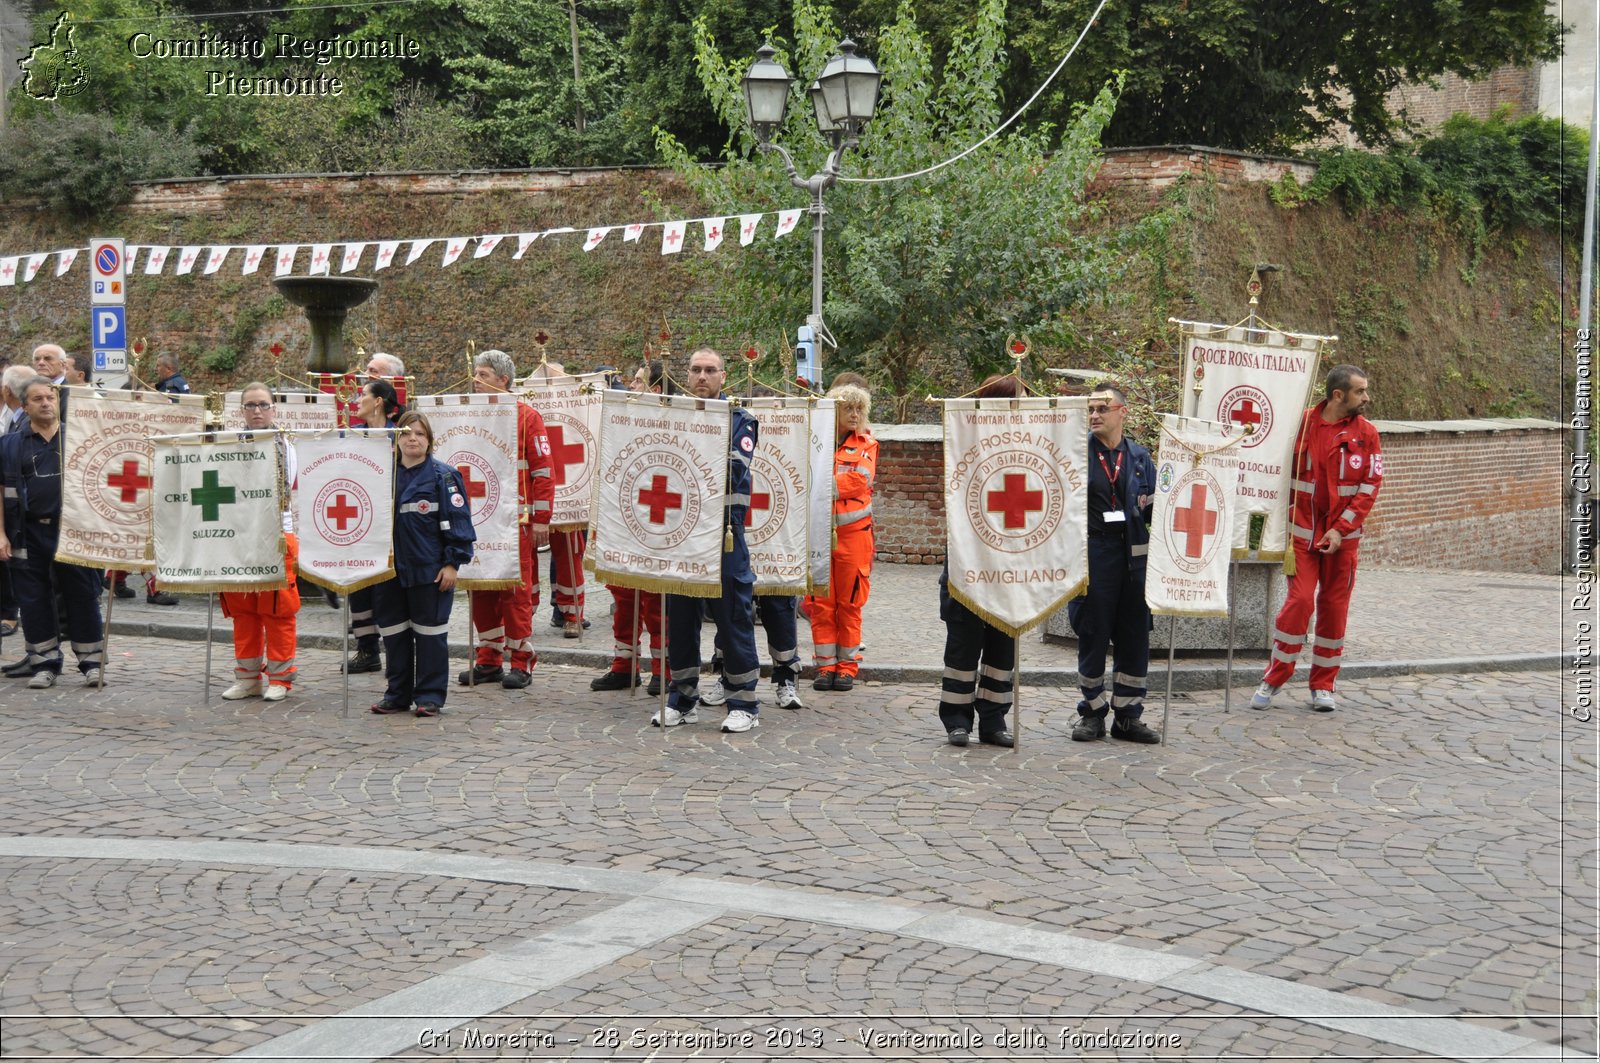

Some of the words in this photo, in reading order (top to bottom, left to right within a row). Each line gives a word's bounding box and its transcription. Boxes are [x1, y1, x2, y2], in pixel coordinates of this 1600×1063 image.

[98, 311, 118, 345] P
[107, 357, 110, 365] 1
[112, 357, 124, 365] ora
[1192, 345, 1227, 365] CROCE
[1227, 350, 1260, 370] ROSSA
[556, 390, 568, 398] DEL
[1235, 389, 1262, 400] GINEVRA
[532, 400, 563, 410] ROSSA
[74, 409, 98, 419] CORPO
[102, 410, 141, 421] VOLONTARI
[144, 413, 157, 422] DEL
[161, 414, 197, 425] SOCCORSO
[286, 411, 298, 420] DEL
[301, 412, 329, 420] SOCCORSO
[754, 414, 767, 423] DEL
[770, 414, 805, 424] SOCCORSO
[1010, 414, 1025, 424] DEL
[1028, 413, 1067, 424] SOCCORSO
[634, 417, 671, 430] VOLONTARI
[674, 421, 687, 432] DEL
[761, 426, 790, 436] PIONIERI
[447, 425, 478, 439] ROSSA
[67, 432, 102, 471] CROCE
[103, 423, 149, 438] ROSSA
[207, 451, 266, 463] ASSISTENZA
[949, 444, 980, 491] CROCE
[980, 431, 1032, 451] ROSSA
[1036, 435, 1082, 493] ITALIANA
[997, 453, 1046, 473] GINEVRA
[1160, 450, 1186, 463] CROCE
[301, 454, 335, 477] VOLONTARI
[348, 453, 385, 475] SOCCORSO
[604, 442, 635, 484] CROCE
[635, 432, 679, 449] ROSSA
[681, 439, 718, 498] ITALIANA
[634, 460, 645, 472] DI
[647, 453, 687, 476] GINEVRA
[763, 442, 805, 495] ITALIANA
[982, 462, 994, 475] DI
[1247, 461, 1282, 475] LOCALE
[480, 461, 489, 471] 22
[486, 470, 499, 503] AGOSTO
[686, 476, 696, 490] 22
[771, 475, 782, 489] 22
[1044, 472, 1055, 486] 22
[241, 489, 273, 500] VERDE
[316, 481, 345, 513] CONVENZIONE
[351, 485, 370, 513] GINEVRA
[1241, 486, 1256, 497] DEL
[621, 471, 647, 542] CONVENZIONE
[683, 492, 699, 530] AGOSTO
[772, 490, 787, 526] AGOSTO
[969, 475, 1003, 548] CONVENZIONE
[1045, 488, 1062, 528] AGOSTO
[65, 528, 121, 544] GRUPPO
[126, 533, 140, 545] DI
[192, 529, 236, 539] SALUZZO
[753, 523, 774, 542] 1864
[1024, 527, 1049, 548] 1864
[65, 541, 128, 559] COMITATO
[312, 560, 338, 568] Gruppo
[338, 559, 345, 567] di
[603, 550, 653, 569] GRUPPO
[658, 559, 672, 571] DI
[675, 560, 709, 575] ALBA
[786, 553, 797, 563] DI
[221, 565, 279, 576] SOCCORSO
[965, 568, 1067, 584] SAVIGLIANO
[1166, 588, 1212, 601] MORETTA
